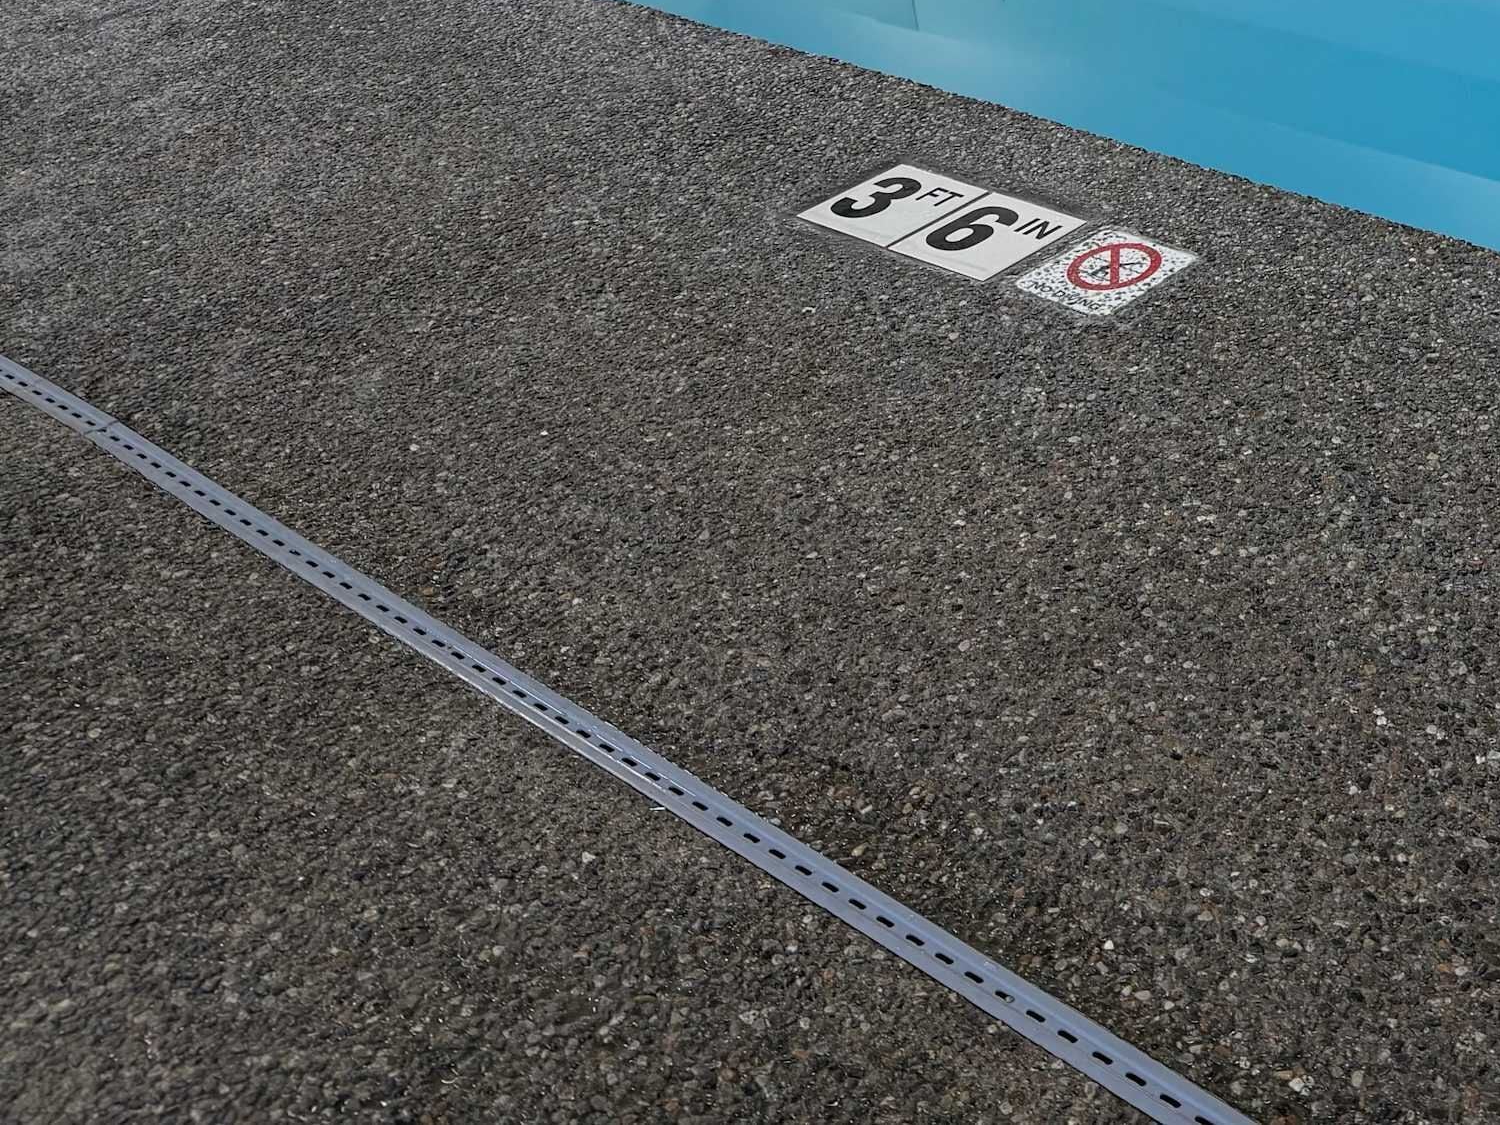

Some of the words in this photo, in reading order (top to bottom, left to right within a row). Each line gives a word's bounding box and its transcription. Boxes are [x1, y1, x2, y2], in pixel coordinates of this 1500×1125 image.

[830, 177, 922, 219] 3
[915, 186, 965, 207] FT
[925, 206, 1019, 252] 6
[1013, 217, 1063, 241] IN
[1026, 280, 1054, 293] NO
[1052, 289, 1103, 311] DIVING
